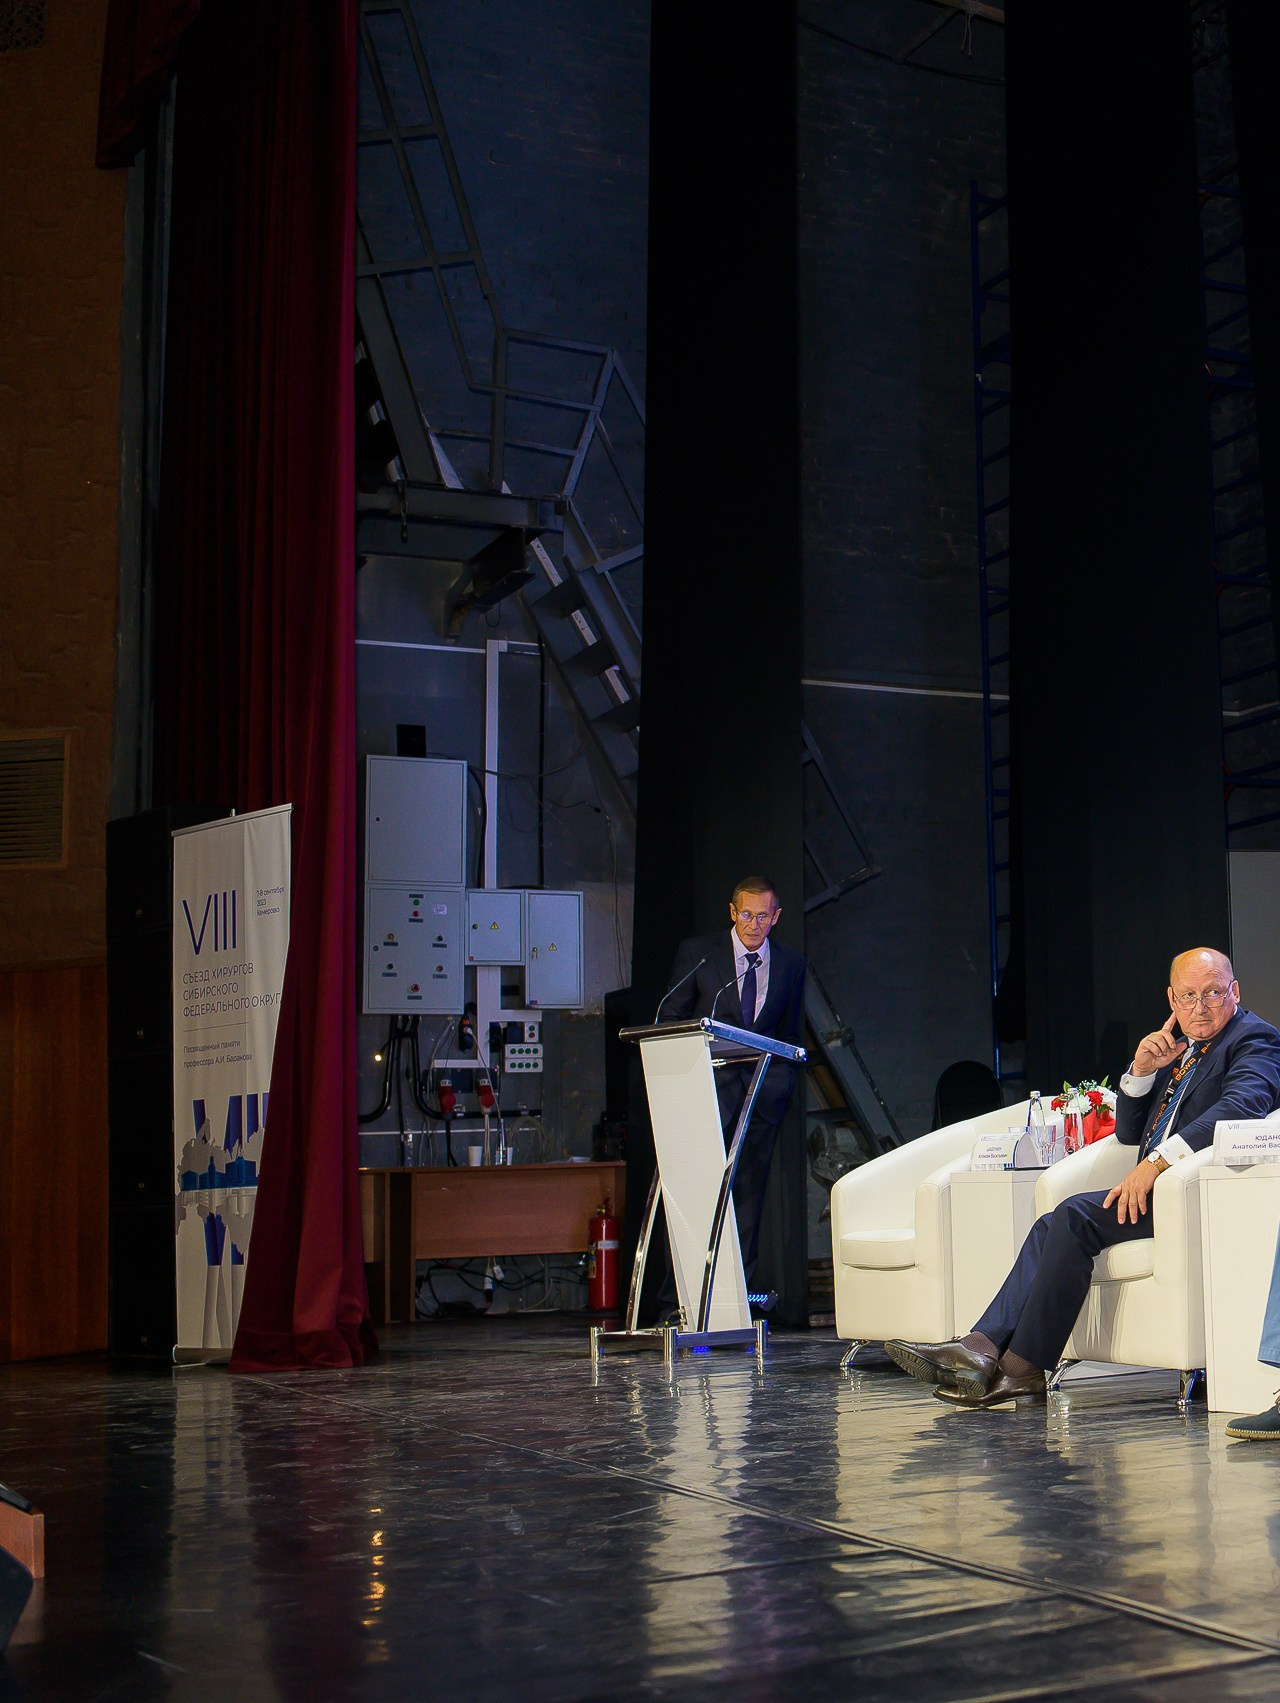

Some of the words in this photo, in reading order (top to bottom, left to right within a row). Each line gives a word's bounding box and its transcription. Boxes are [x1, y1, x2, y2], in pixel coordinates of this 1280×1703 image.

[182, 889, 237, 955] VIII
[183, 970, 210, 984] СЪЕЗД
[212, 962, 253, 979] ХИРУРГОВ
[183, 982, 239, 1001] СИБИРСКОГО
[183, 997, 250, 1017] ФЕДЕРАЛЬНОГО
[252, 992, 281, 1007] ОКРУГ
[1175, 1057, 1197, 1082] BOWA
[1232, 1142, 1267, 1150] Анатолий
